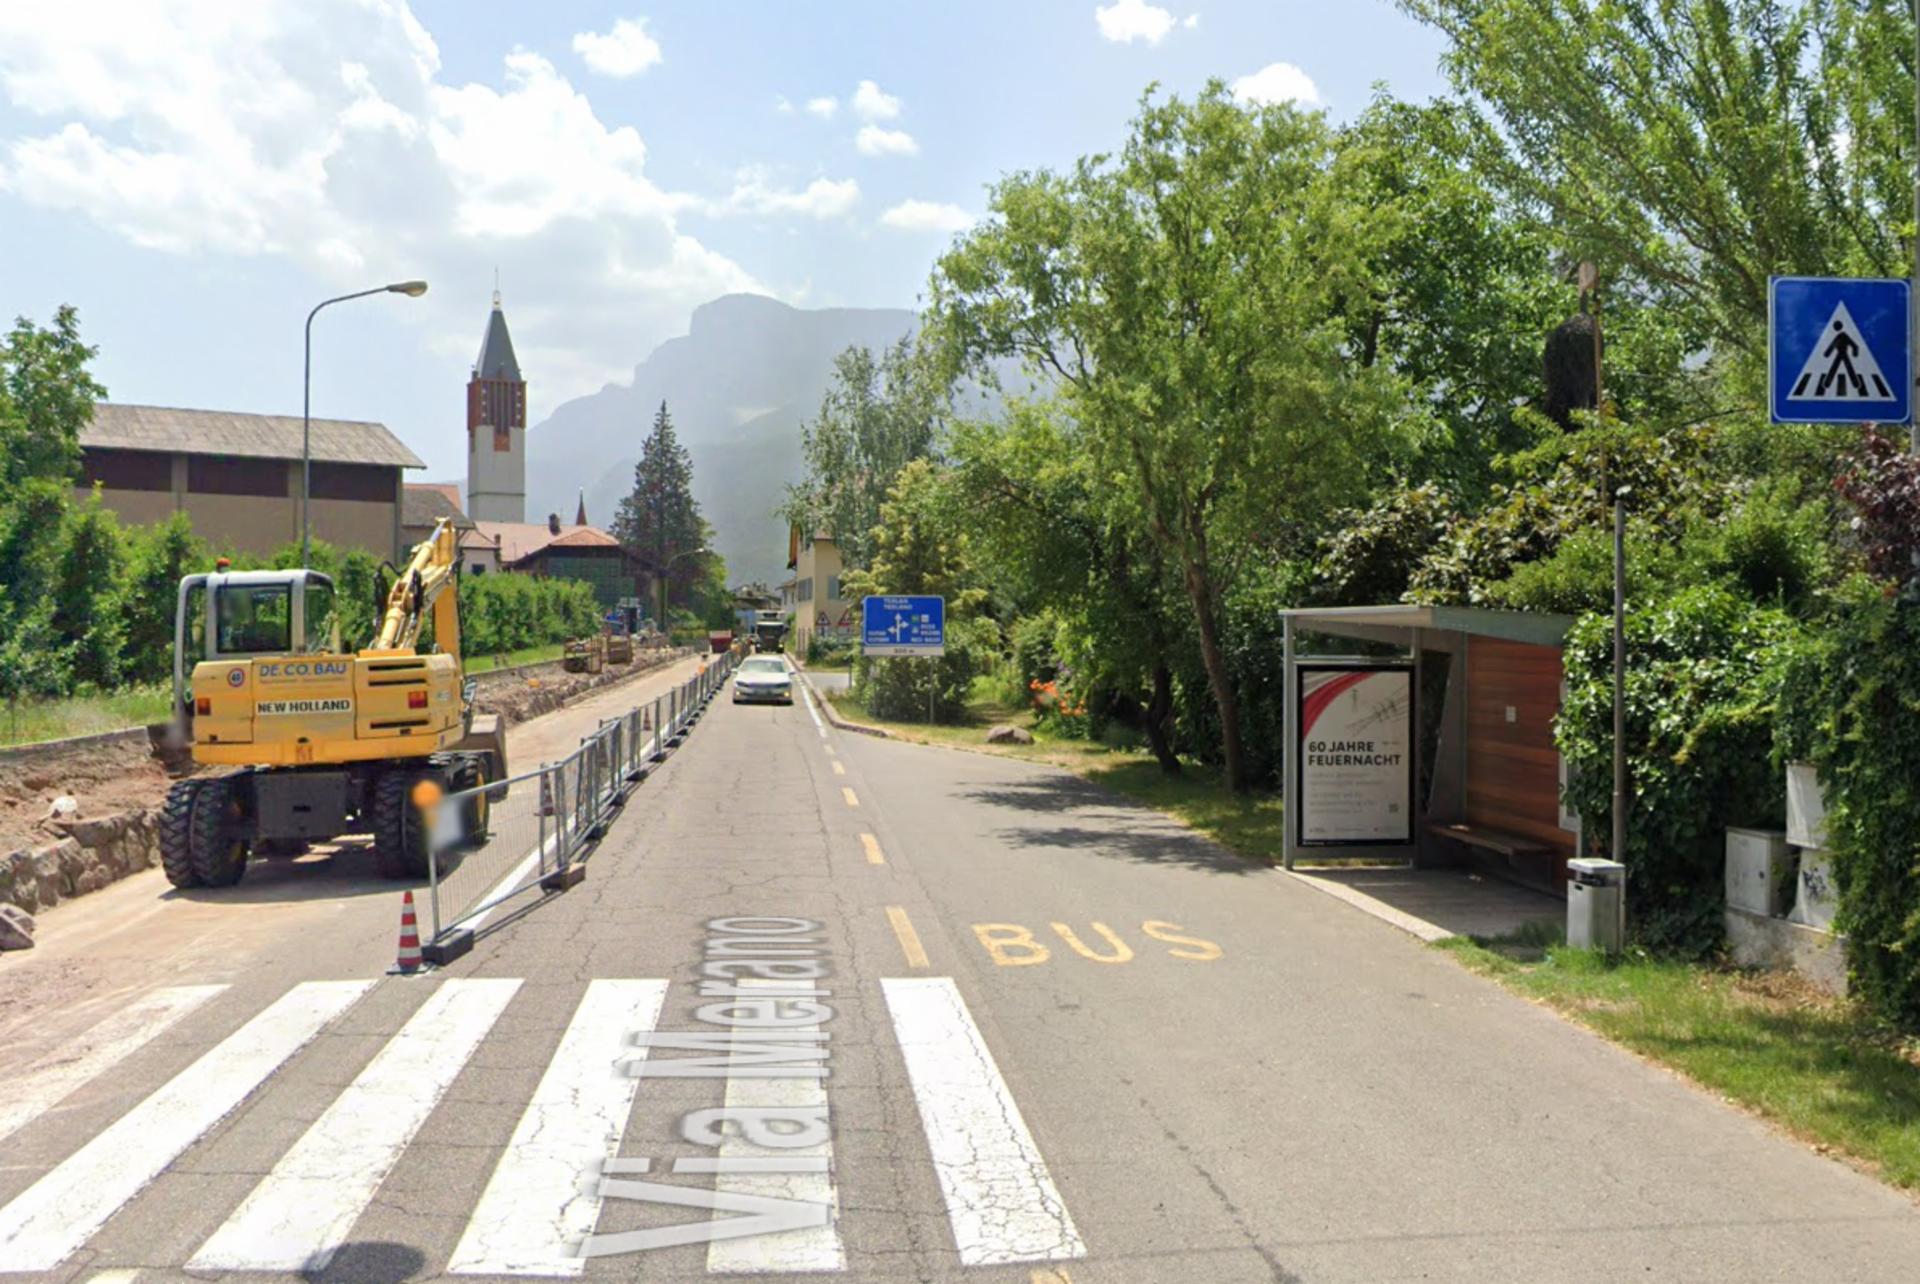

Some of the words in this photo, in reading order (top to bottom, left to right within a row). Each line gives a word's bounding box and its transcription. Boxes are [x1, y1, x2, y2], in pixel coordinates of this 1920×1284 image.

[314, 662, 347, 675] BAU
[257, 702, 287, 713] NEW
[289, 699, 350, 713] HOLLAND
[1308, 741, 1327, 752] 60
[1329, 741, 1375, 752] JAHRE
[1308, 754, 1401, 766] FEUERNACHT
[971, 920, 1223, 966] BUS
